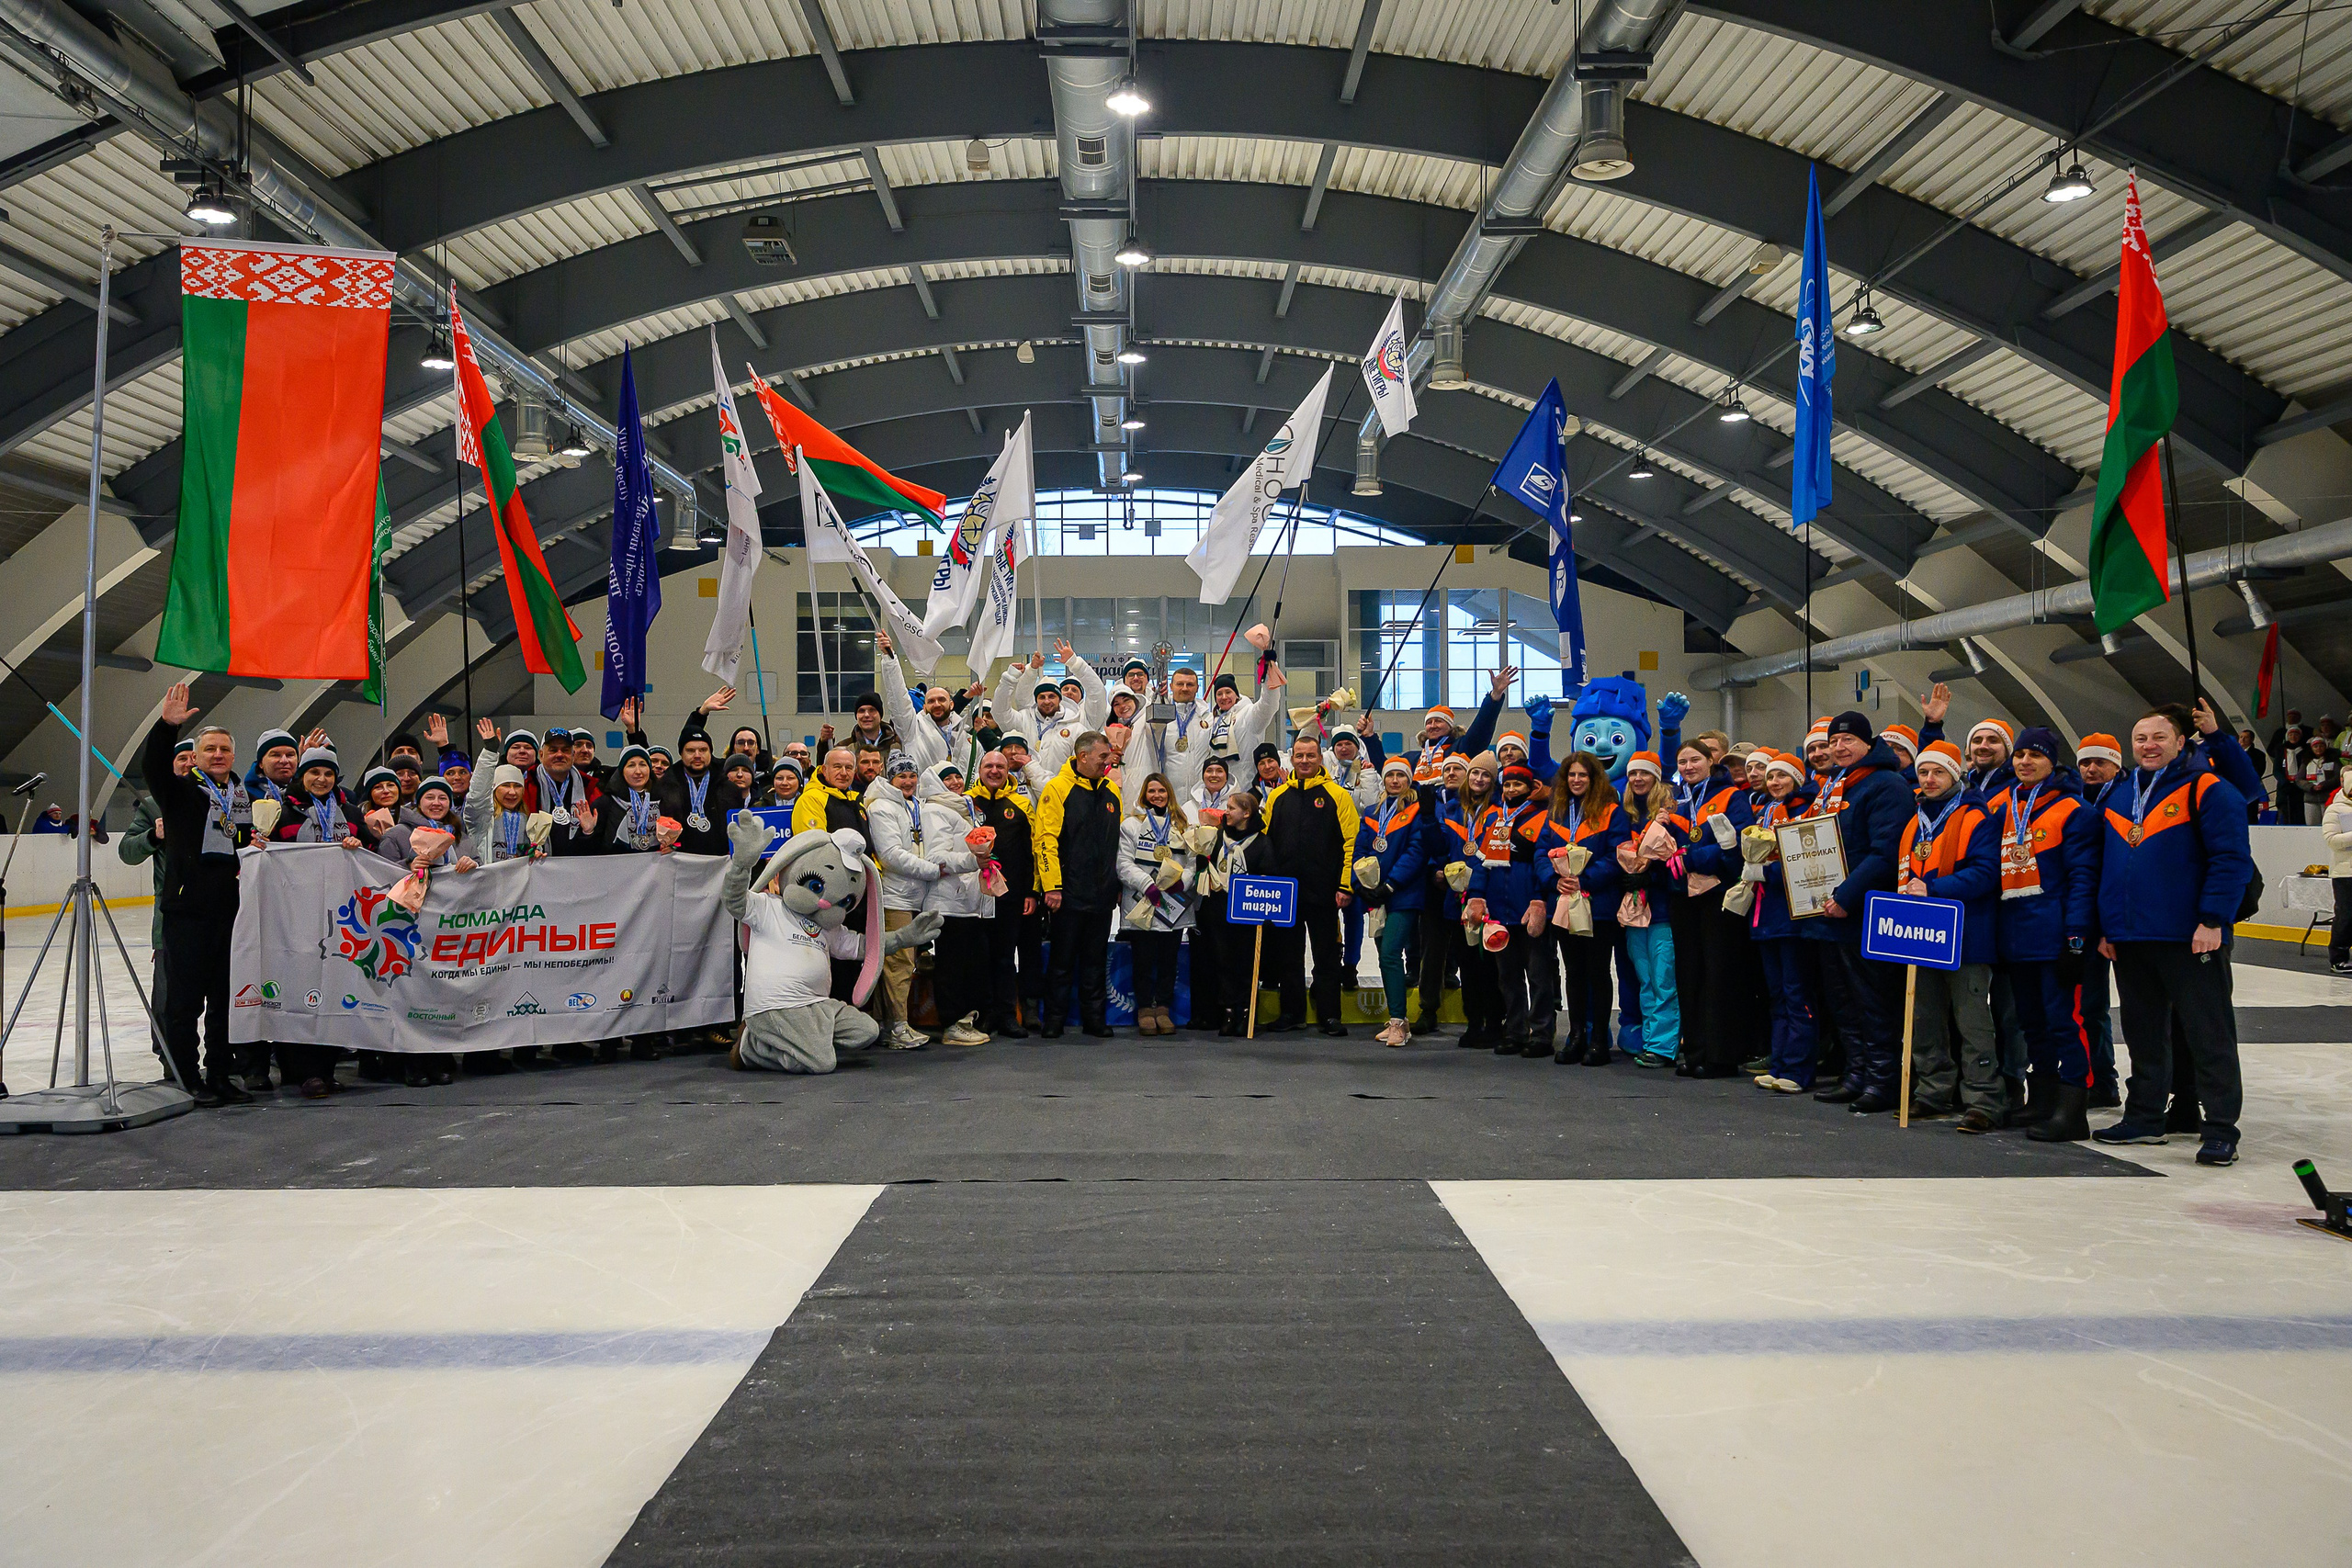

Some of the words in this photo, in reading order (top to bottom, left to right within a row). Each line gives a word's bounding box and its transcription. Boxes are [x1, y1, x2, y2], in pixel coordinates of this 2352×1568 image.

[1254, 457, 1264, 493] Medical
[1250, 506, 1261, 524] Spa
[1041, 841, 1050, 873] BELARUS
[1786, 846, 1838, 863] СЕРТИФИКАТ
[1245, 885, 1282, 899] Белые
[438, 904, 547, 929] КОМАНДА
[1242, 901, 1282, 916] тигры
[792, 933, 812, 942] БЕЛЫЕ
[1878, 917, 1947, 944] Молния
[431, 921, 616, 968] ЕДИНЫЕ
[431, 970, 459, 980] КОГДА
[461, 969, 478, 978] МЫ
[481, 963, 510, 976] ЕДИНЫ
[524, 961, 542, 970] МЫ
[544, 956, 615, 969] НЕПОБЕДИМЫ!
[407, 1011, 457, 1021] ВОСТОЧНЫЙ
